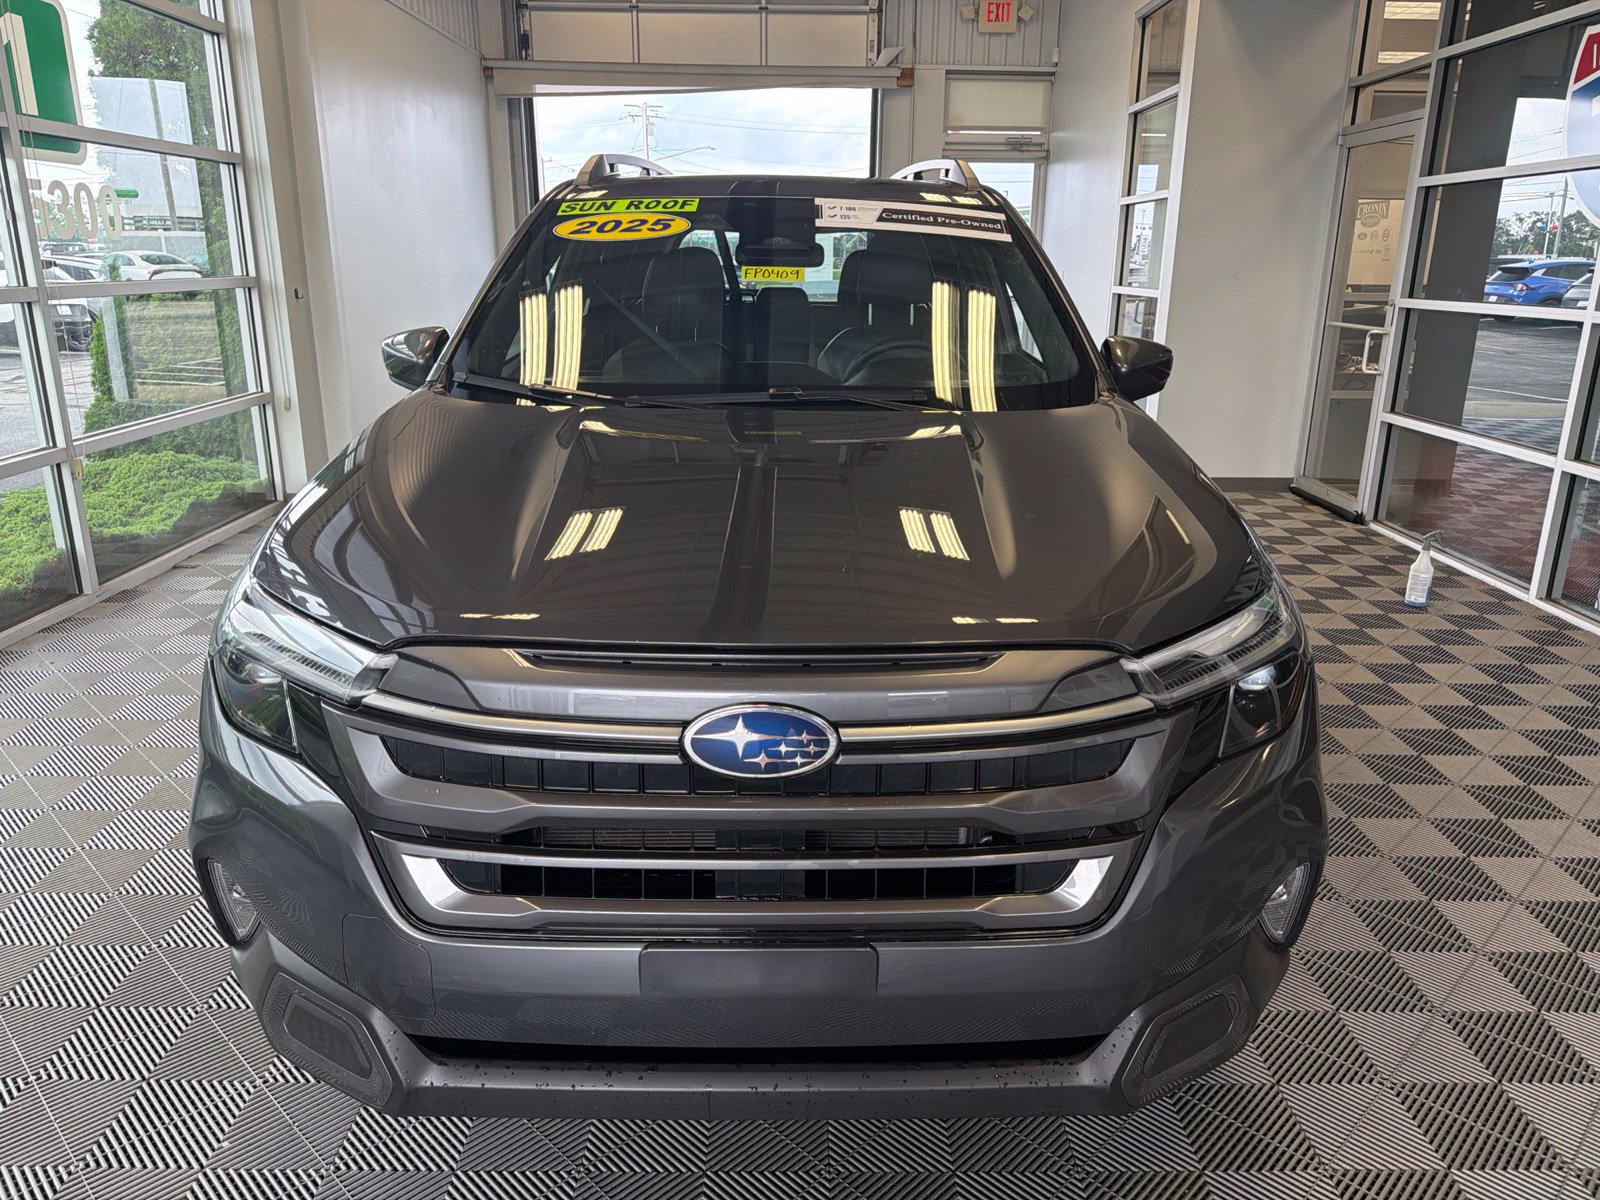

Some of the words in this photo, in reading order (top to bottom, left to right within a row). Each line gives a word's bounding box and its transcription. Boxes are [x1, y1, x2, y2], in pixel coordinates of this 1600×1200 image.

[986, 2, 1012, 23] EXIT
[561, 200, 618, 213] SUN
[624, 199, 696, 211] ROOF
[567, 218, 677, 235] 2025
[882, 212, 934, 223] Certified
[937, 216, 1002, 229] Pre-Owned
[744, 267, 800, 280] FP0409
